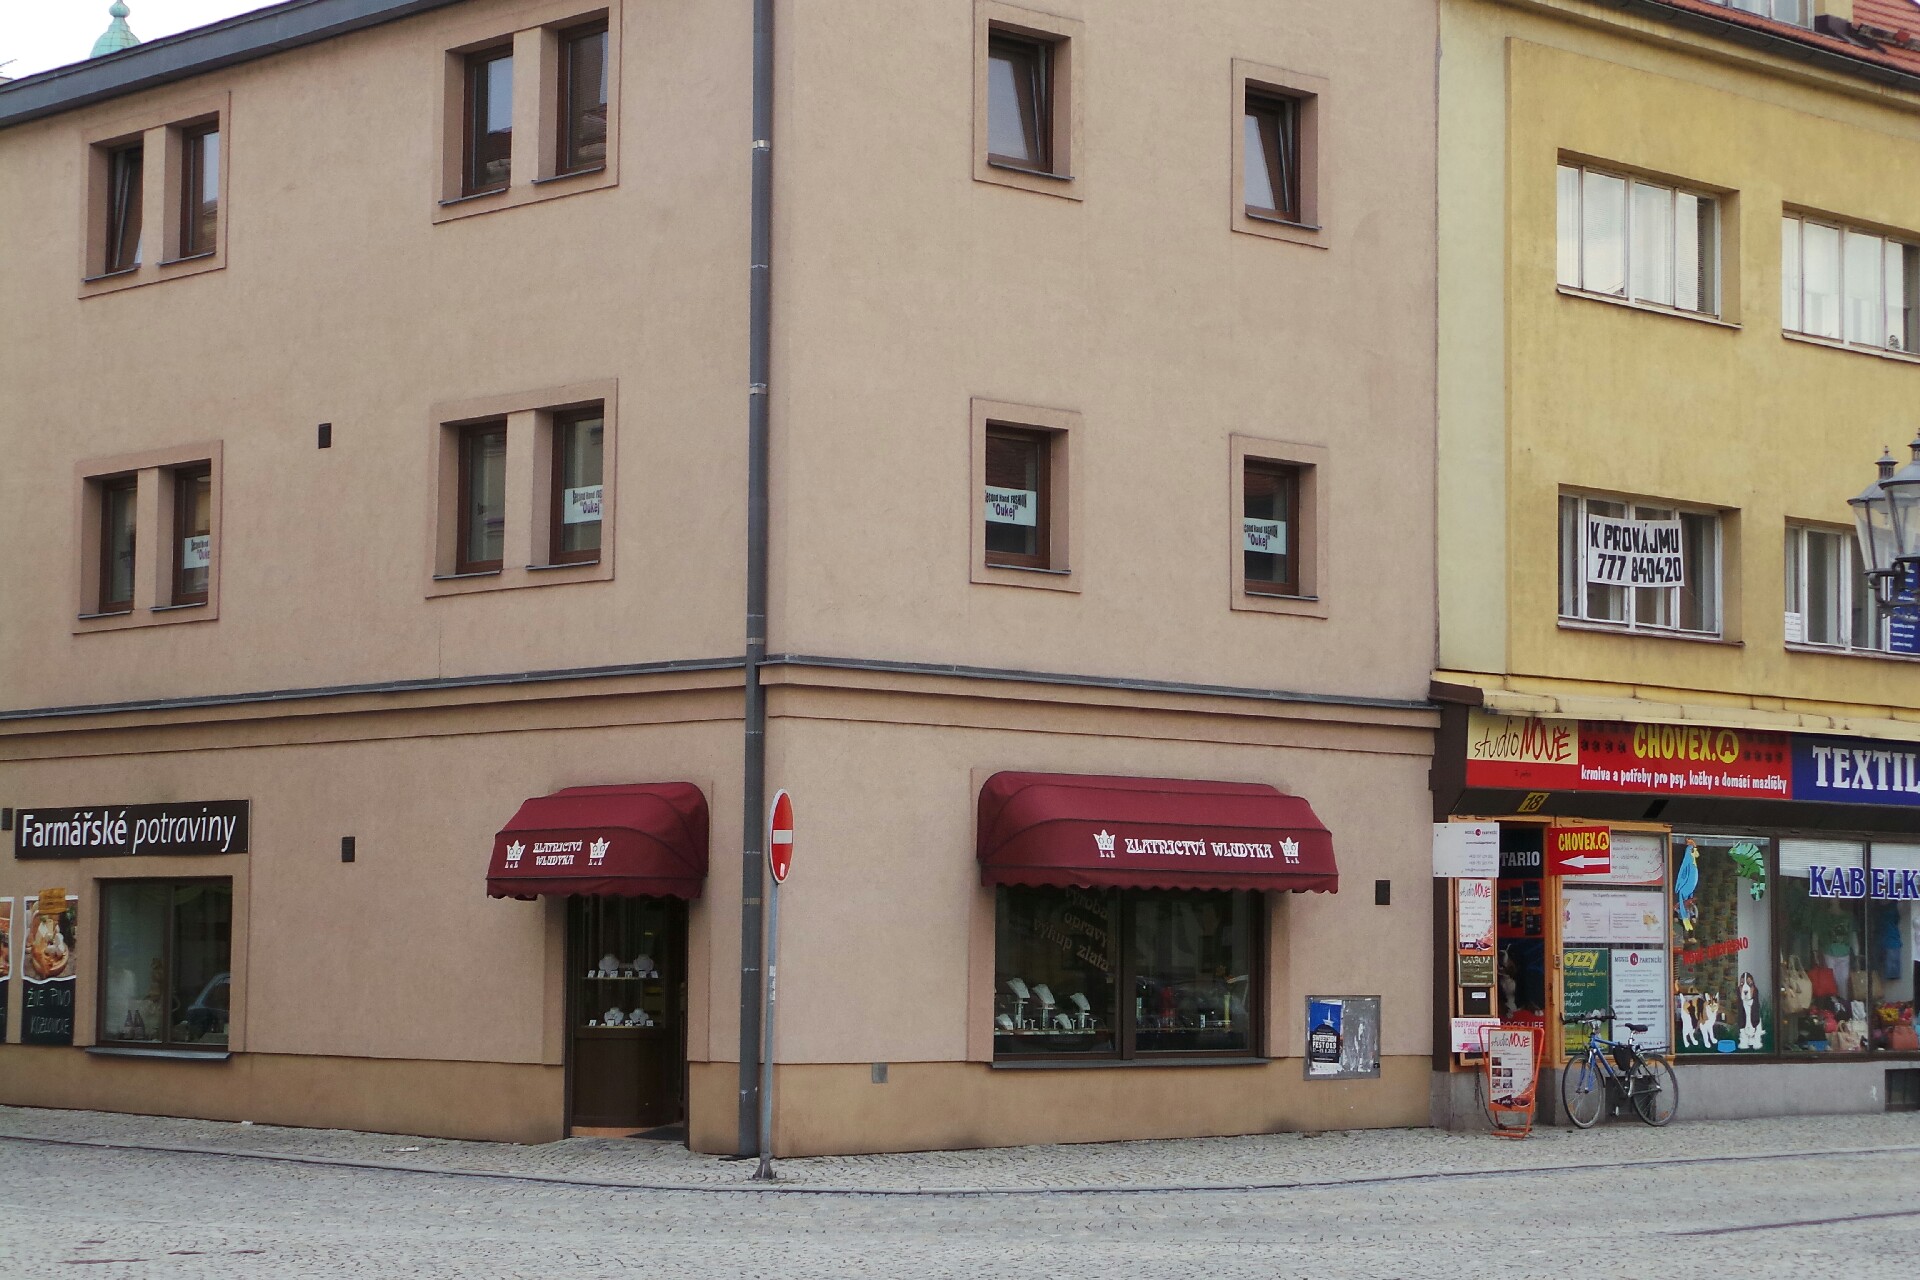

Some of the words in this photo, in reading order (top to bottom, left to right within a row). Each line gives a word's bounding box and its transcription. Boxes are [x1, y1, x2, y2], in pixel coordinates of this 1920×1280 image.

[985, 490, 998, 503] econd
[1590, 521, 1600, 549] K
[1603, 523, 1680, 554] PRONÁJMU
[1597, 553, 1627, 581] 777
[1631, 556, 1682, 583] 840420
[1581, 764, 1611, 781] krmiva
[1612, 770, 1619, 781] a
[1620, 767, 1652, 788] potřeby
[1654, 771, 1668, 789] pro
[1669, 772, 1687, 789] psy,
[1689, 769, 1713, 790] kočky
[1714, 775, 1720, 786] a
[1721, 771, 1751, 789] domácí
[1752, 774, 1787, 794] mazlíčky
[1812, 745, 1920, 793] TEXTIL
[1523, 794, 1545, 811] 18
[22, 811, 127, 847] Farmářské
[132, 807, 237, 855] potraviny
[1124, 838, 1207, 856] ZLATNICTVÍ
[1563, 951, 1599, 969] OZZY
